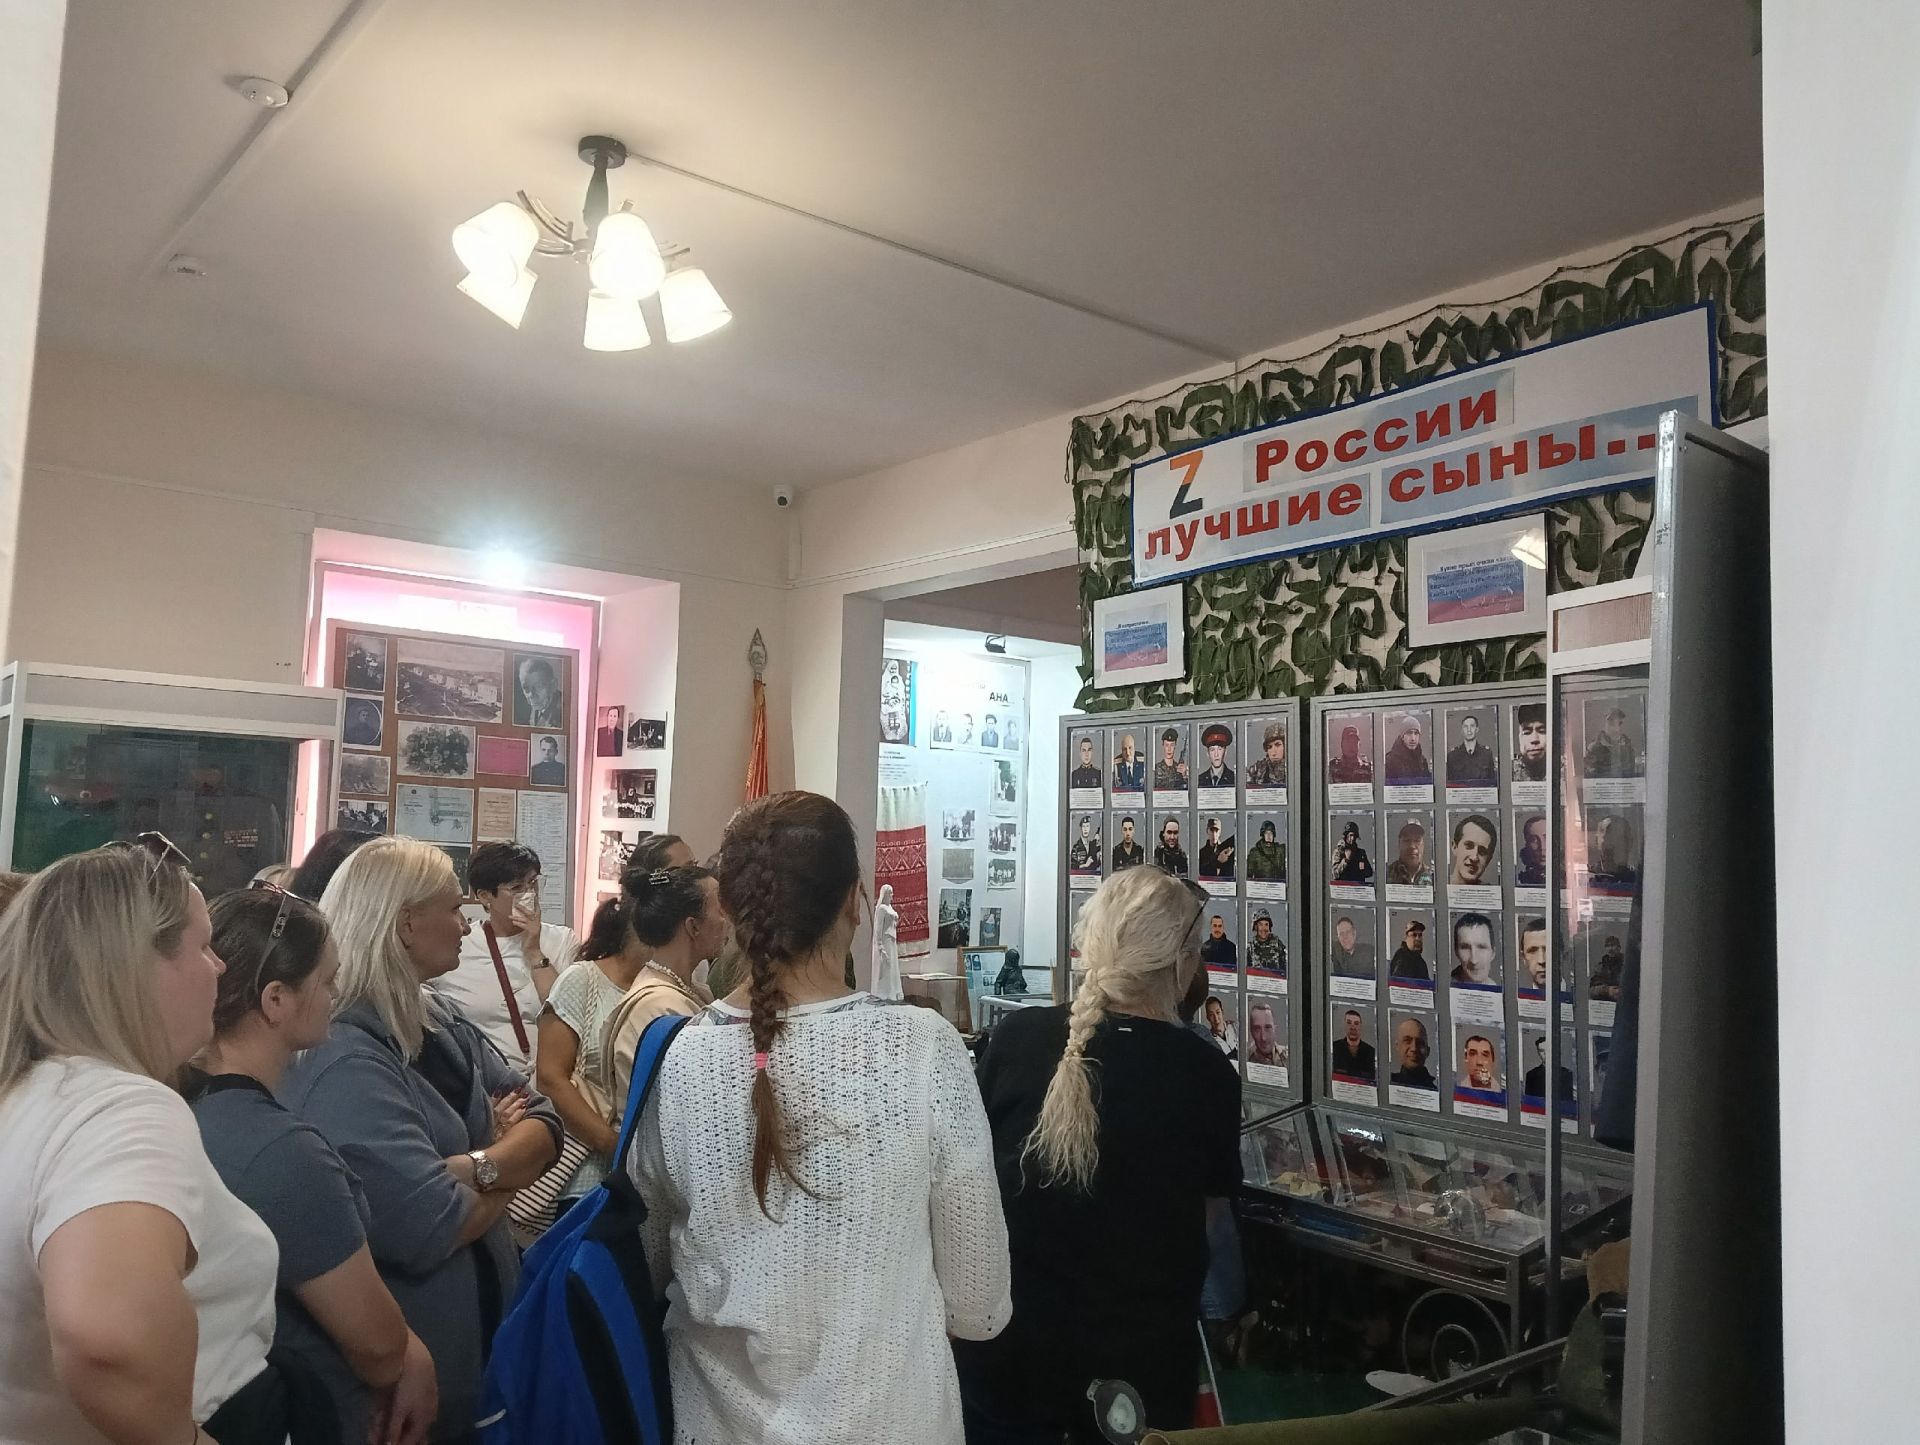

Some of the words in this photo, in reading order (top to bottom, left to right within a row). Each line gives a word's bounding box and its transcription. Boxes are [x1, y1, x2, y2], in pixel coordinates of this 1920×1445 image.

[1169, 450, 1204, 520] Z
[1256, 388, 1497, 484] России
[1144, 483, 1363, 562] лучшие
